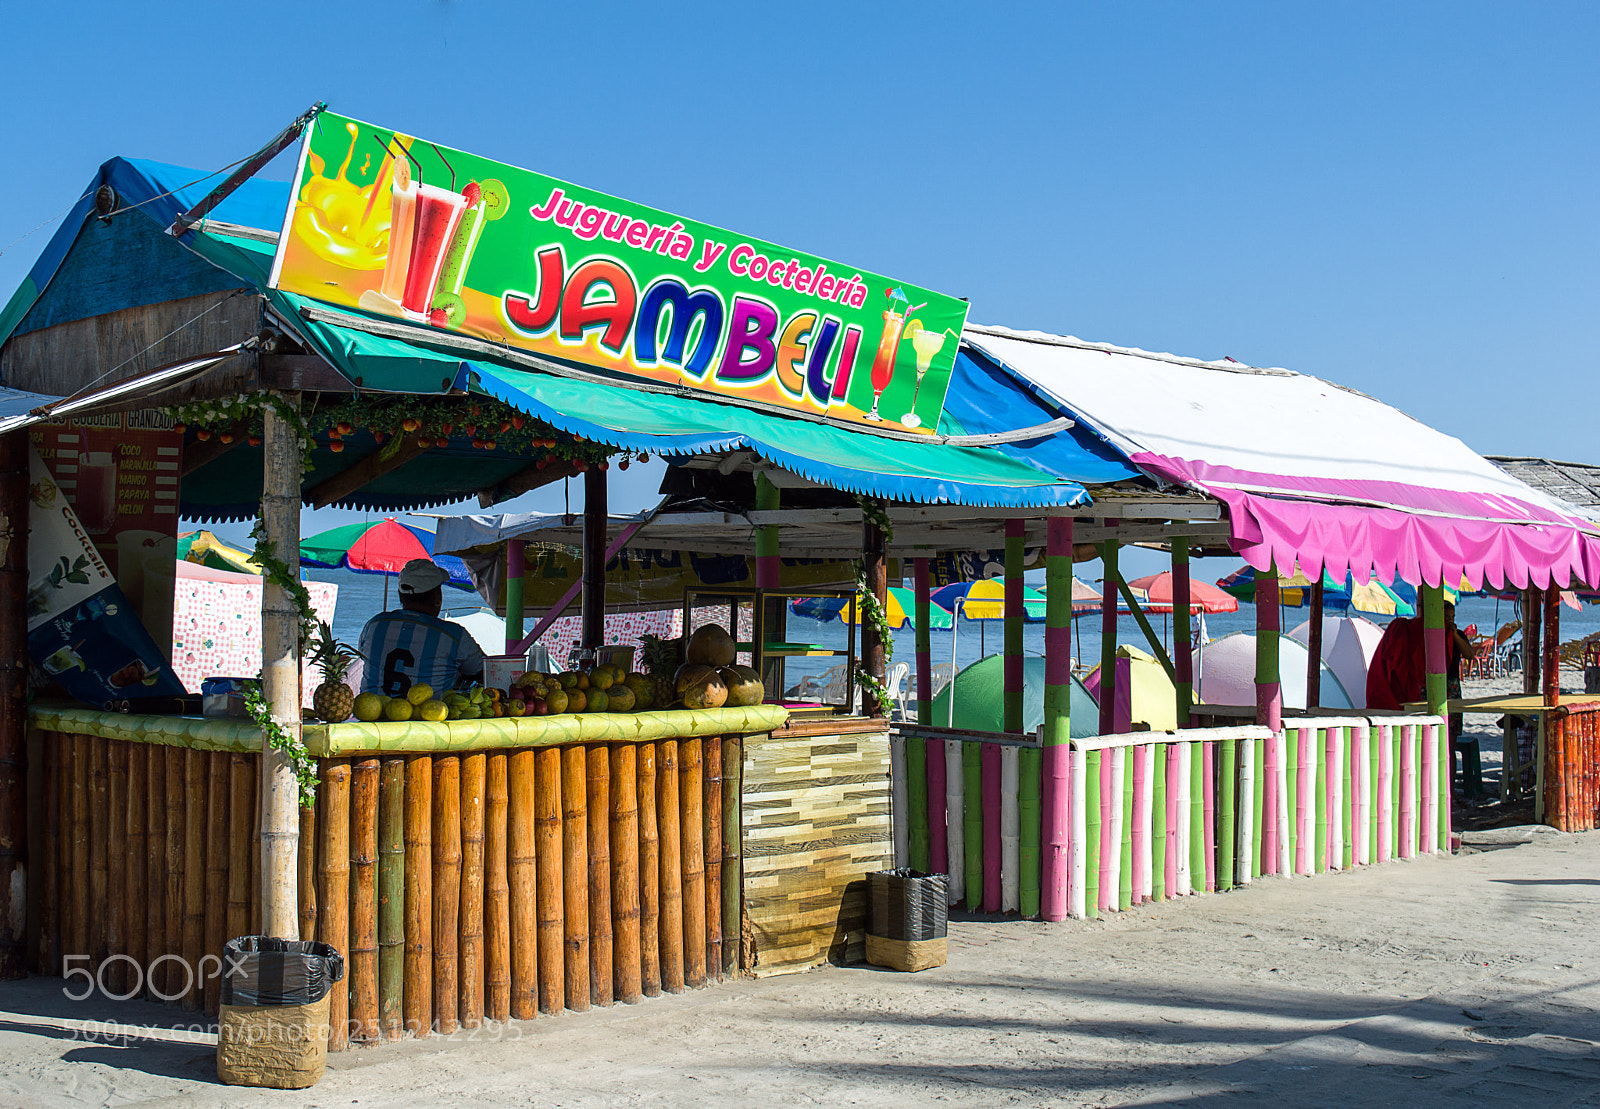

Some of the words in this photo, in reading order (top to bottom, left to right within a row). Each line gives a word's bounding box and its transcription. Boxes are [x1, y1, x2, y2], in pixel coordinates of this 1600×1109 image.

[532, 189, 693, 259] Juguería
[697, 241, 725, 270] y
[730, 246, 868, 309] Coctelería
[507, 248, 861, 403] JAMBELI
[128, 409, 177, 429] GRANIZADO
[121, 445, 142, 456] COCO
[120, 460, 157, 471] NARANJILLA
[119, 474, 147, 485] MANGO
[119, 489, 150, 500] PAPAYA
[118, 504, 144, 515] MELON
[62, 507, 108, 579] Cocktails
[384, 648, 415, 698] 6
